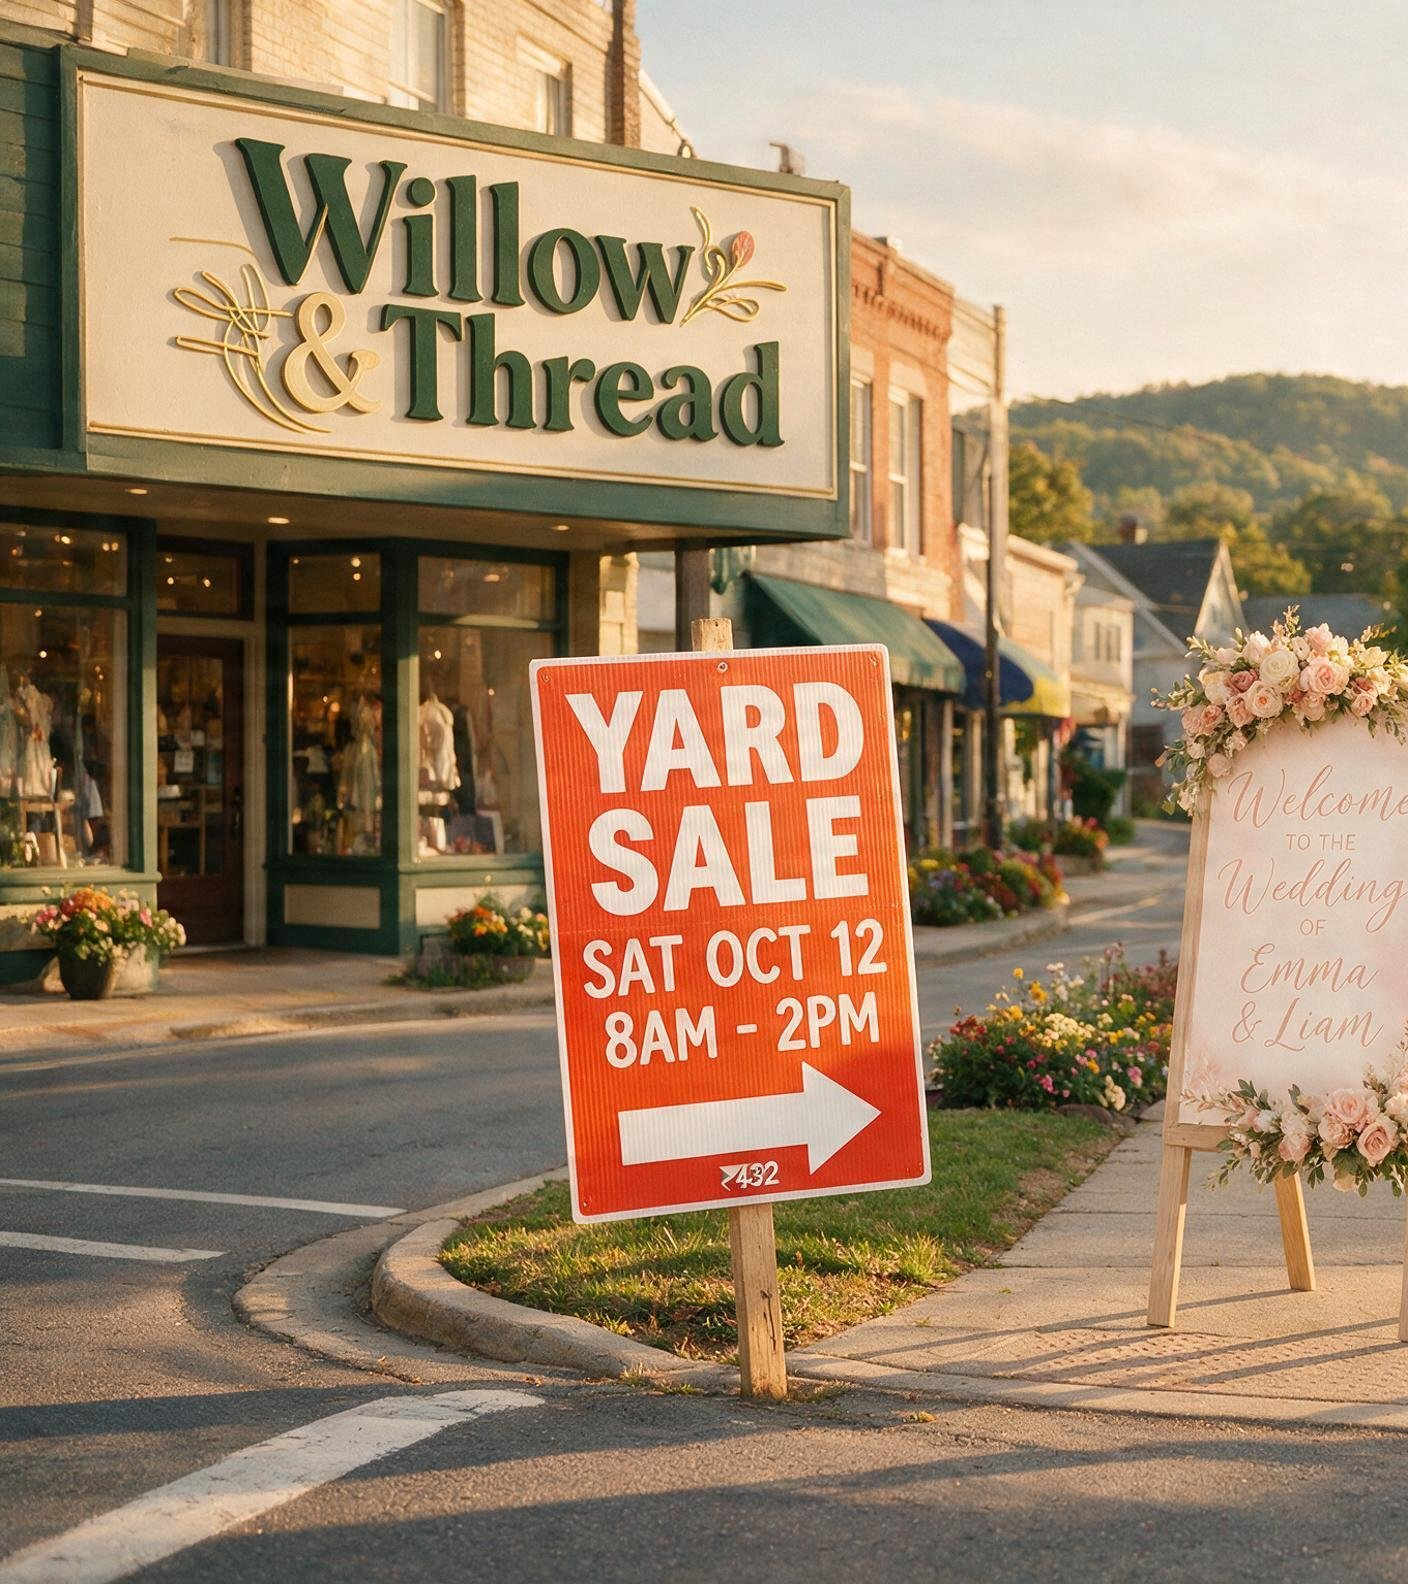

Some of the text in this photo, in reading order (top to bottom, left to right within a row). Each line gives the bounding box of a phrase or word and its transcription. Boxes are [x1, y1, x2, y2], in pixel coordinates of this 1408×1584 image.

[235, 138, 695, 324] Willow
[283, 292, 785, 447] & Thread
[565, 681, 864, 793] YARD
[588, 795, 869, 916] SALE
[1285, 833, 1356, 851] TO THE
[583, 918, 887, 999] SAT OCT 12
[1299, 919, 1327, 936] OF
[1240, 943, 1379, 994] Emma
[604, 991, 880, 1068] 8AM - 2PM
[1231, 997, 1385, 1052] & Liam
